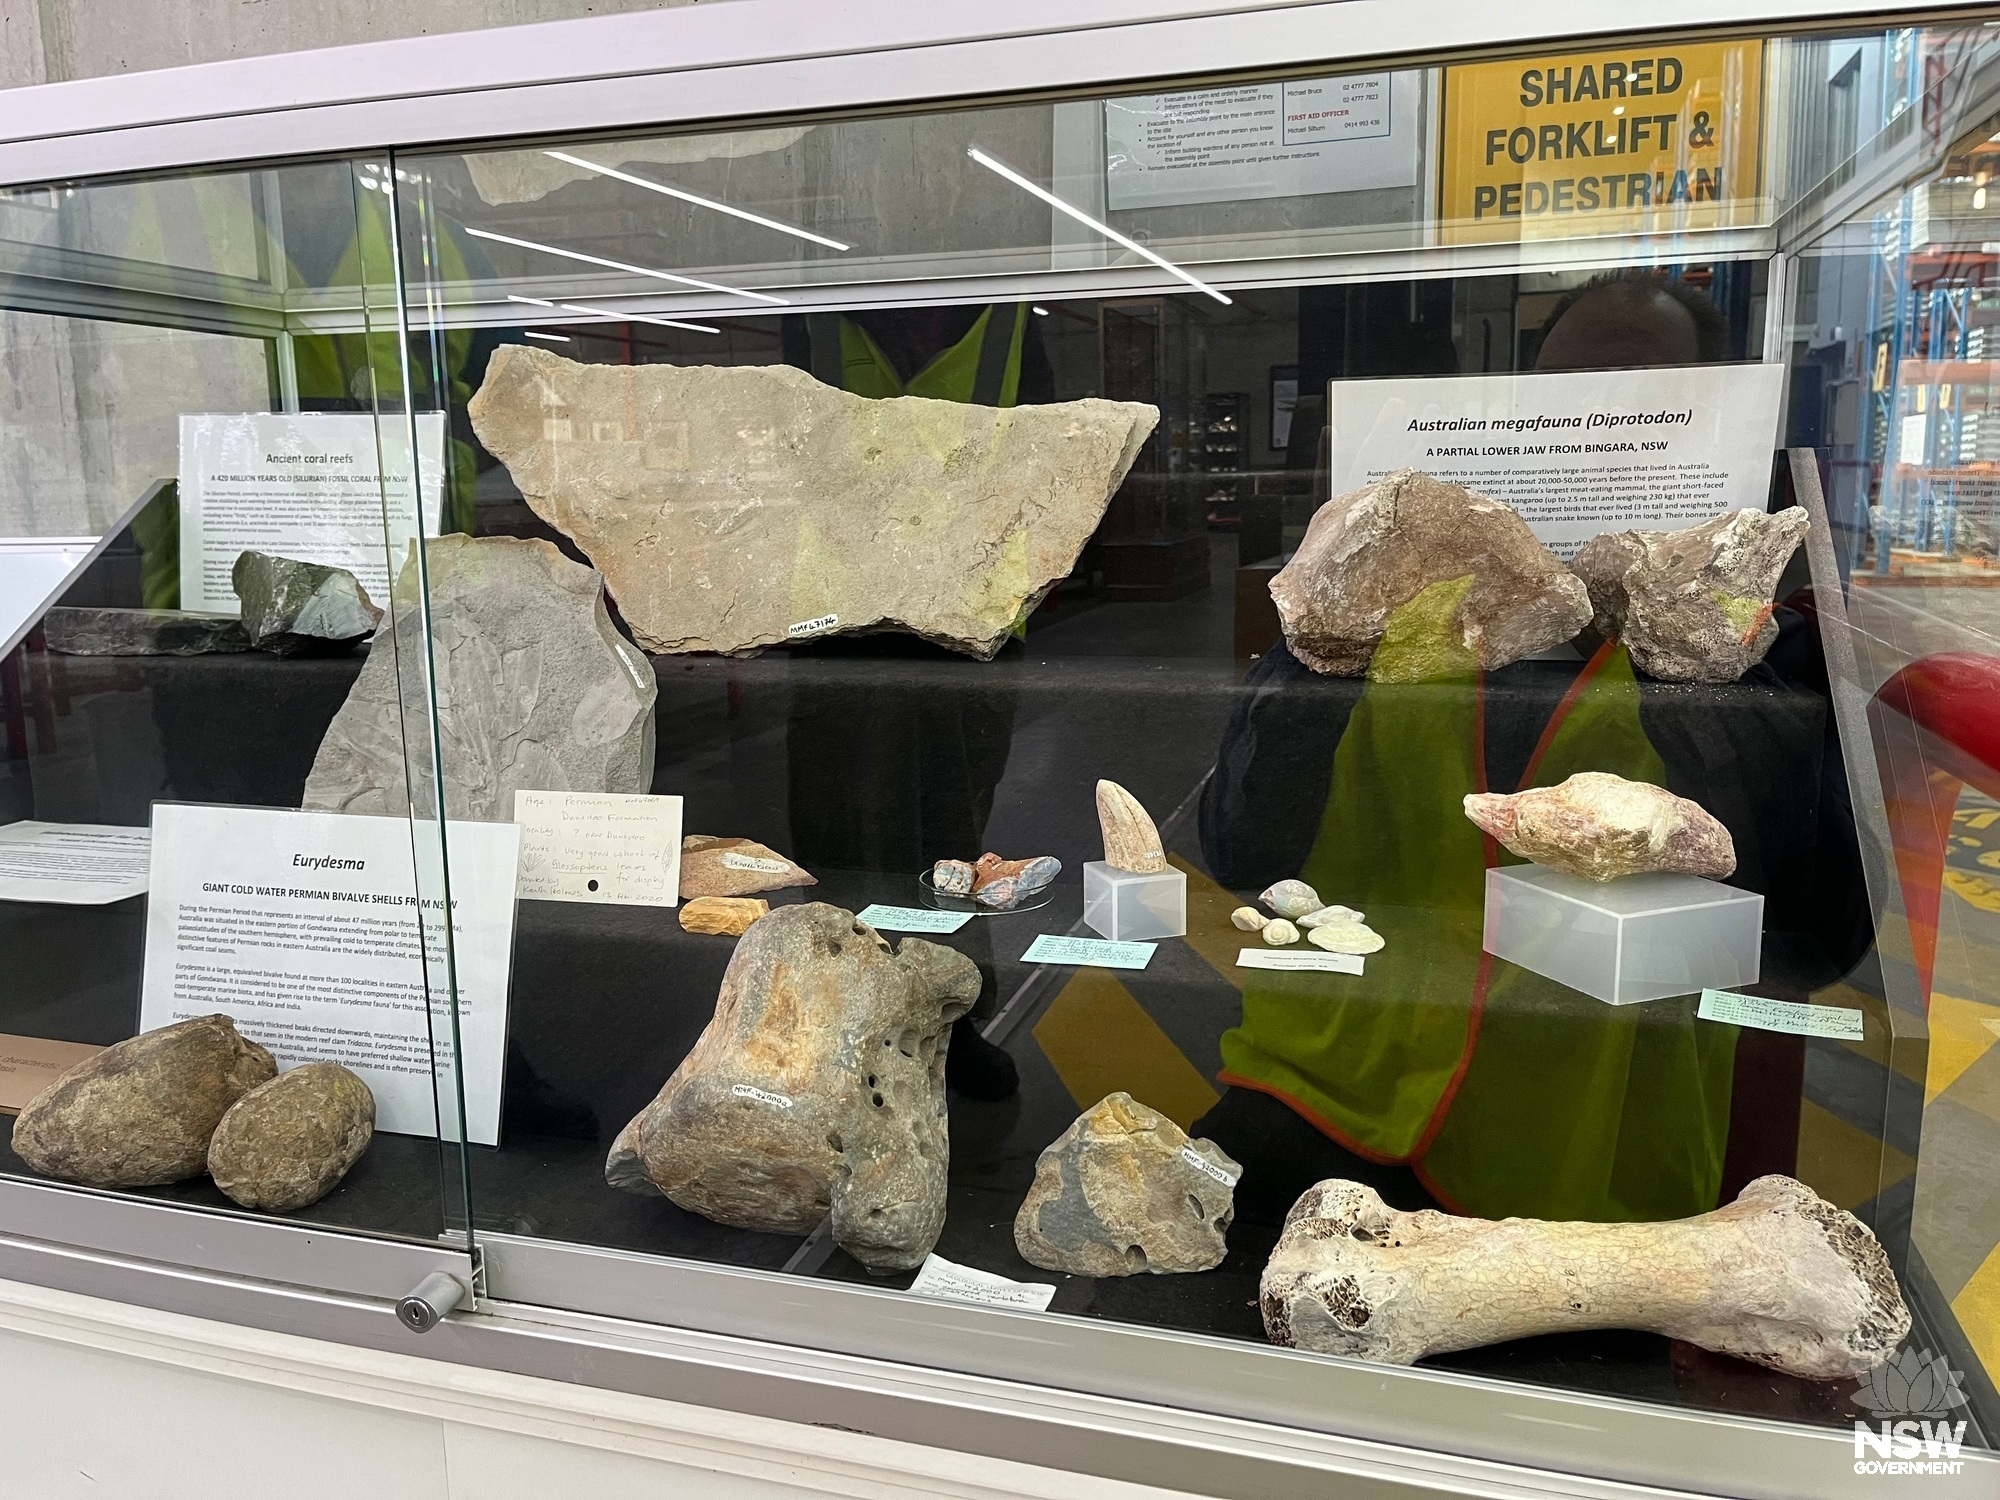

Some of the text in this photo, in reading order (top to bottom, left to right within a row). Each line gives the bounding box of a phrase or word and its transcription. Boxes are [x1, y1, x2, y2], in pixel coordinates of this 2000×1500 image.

[1519, 57, 1683, 107] SHARED
[1288, 88, 1306, 96] Michael
[1288, 113, 1306, 121] FIRST
[1322, 109, 1349, 118] OFFICER
[1288, 126, 1306, 134] Michael
[1485, 112, 1715, 165] FORKLIFT &
[1473, 167, 1722, 221] PEDESTRIAN
[1406, 409, 1693, 432] Australian megafauna (Diprotodon)
[1426, 441, 1668, 456] A PARTIAL LOWER JAW FROM BINGARA, NSW
[266, 453, 353, 464] Ancient coral reefs
[1512, 466, 1560, 476] comparatively
[1562, 466, 1579, 475] large
[1581, 465, 1605, 473] animal
[1606, 466, 1632, 474] species
[293, 475, 327, 483] (SILURIAN)
[351, 475, 372, 483] CORAL
[373, 475, 391, 483] FRM
[1482, 477, 1505, 485] extinct
[1516, 476, 1536, 484] about
[1538, 475, 1587, 484] 20,000-50,000
[1647, 473, 1676, 482] present.
[1545, 485, 1568, 494] largest
[1570, 484, 1612, 493] meat-eating
[1614, 483, 1646, 491] mammal,
[1662, 482, 1680, 492] giant
[1682, 481, 1724, 489] short-faced
[1539, 505, 1562, 514] largest
[1634, 503, 1641, 512] (3
[1680, 501, 1712, 510] weighing
[292, 853, 365, 871] Eurydesma
[202, 883, 229, 893] GIANT
[231, 885, 253, 895] COLD
[256, 887, 286, 897] WATER
[288, 889, 330, 900] PERMIAN
[332, 892, 369, 903] BIVALVE
[372, 895, 402, 905] SHELLS
[405, 896, 430, 908] FRM
[179, 904, 197, 913] During
[208, 906, 231, 914] Permian
[303, 913, 325, 921] interval
[334, 915, 350, 923] about
[360, 917, 380, 925] million
[398, 920, 415, 928] (from
[257, 999, 273, 1007] Africa
